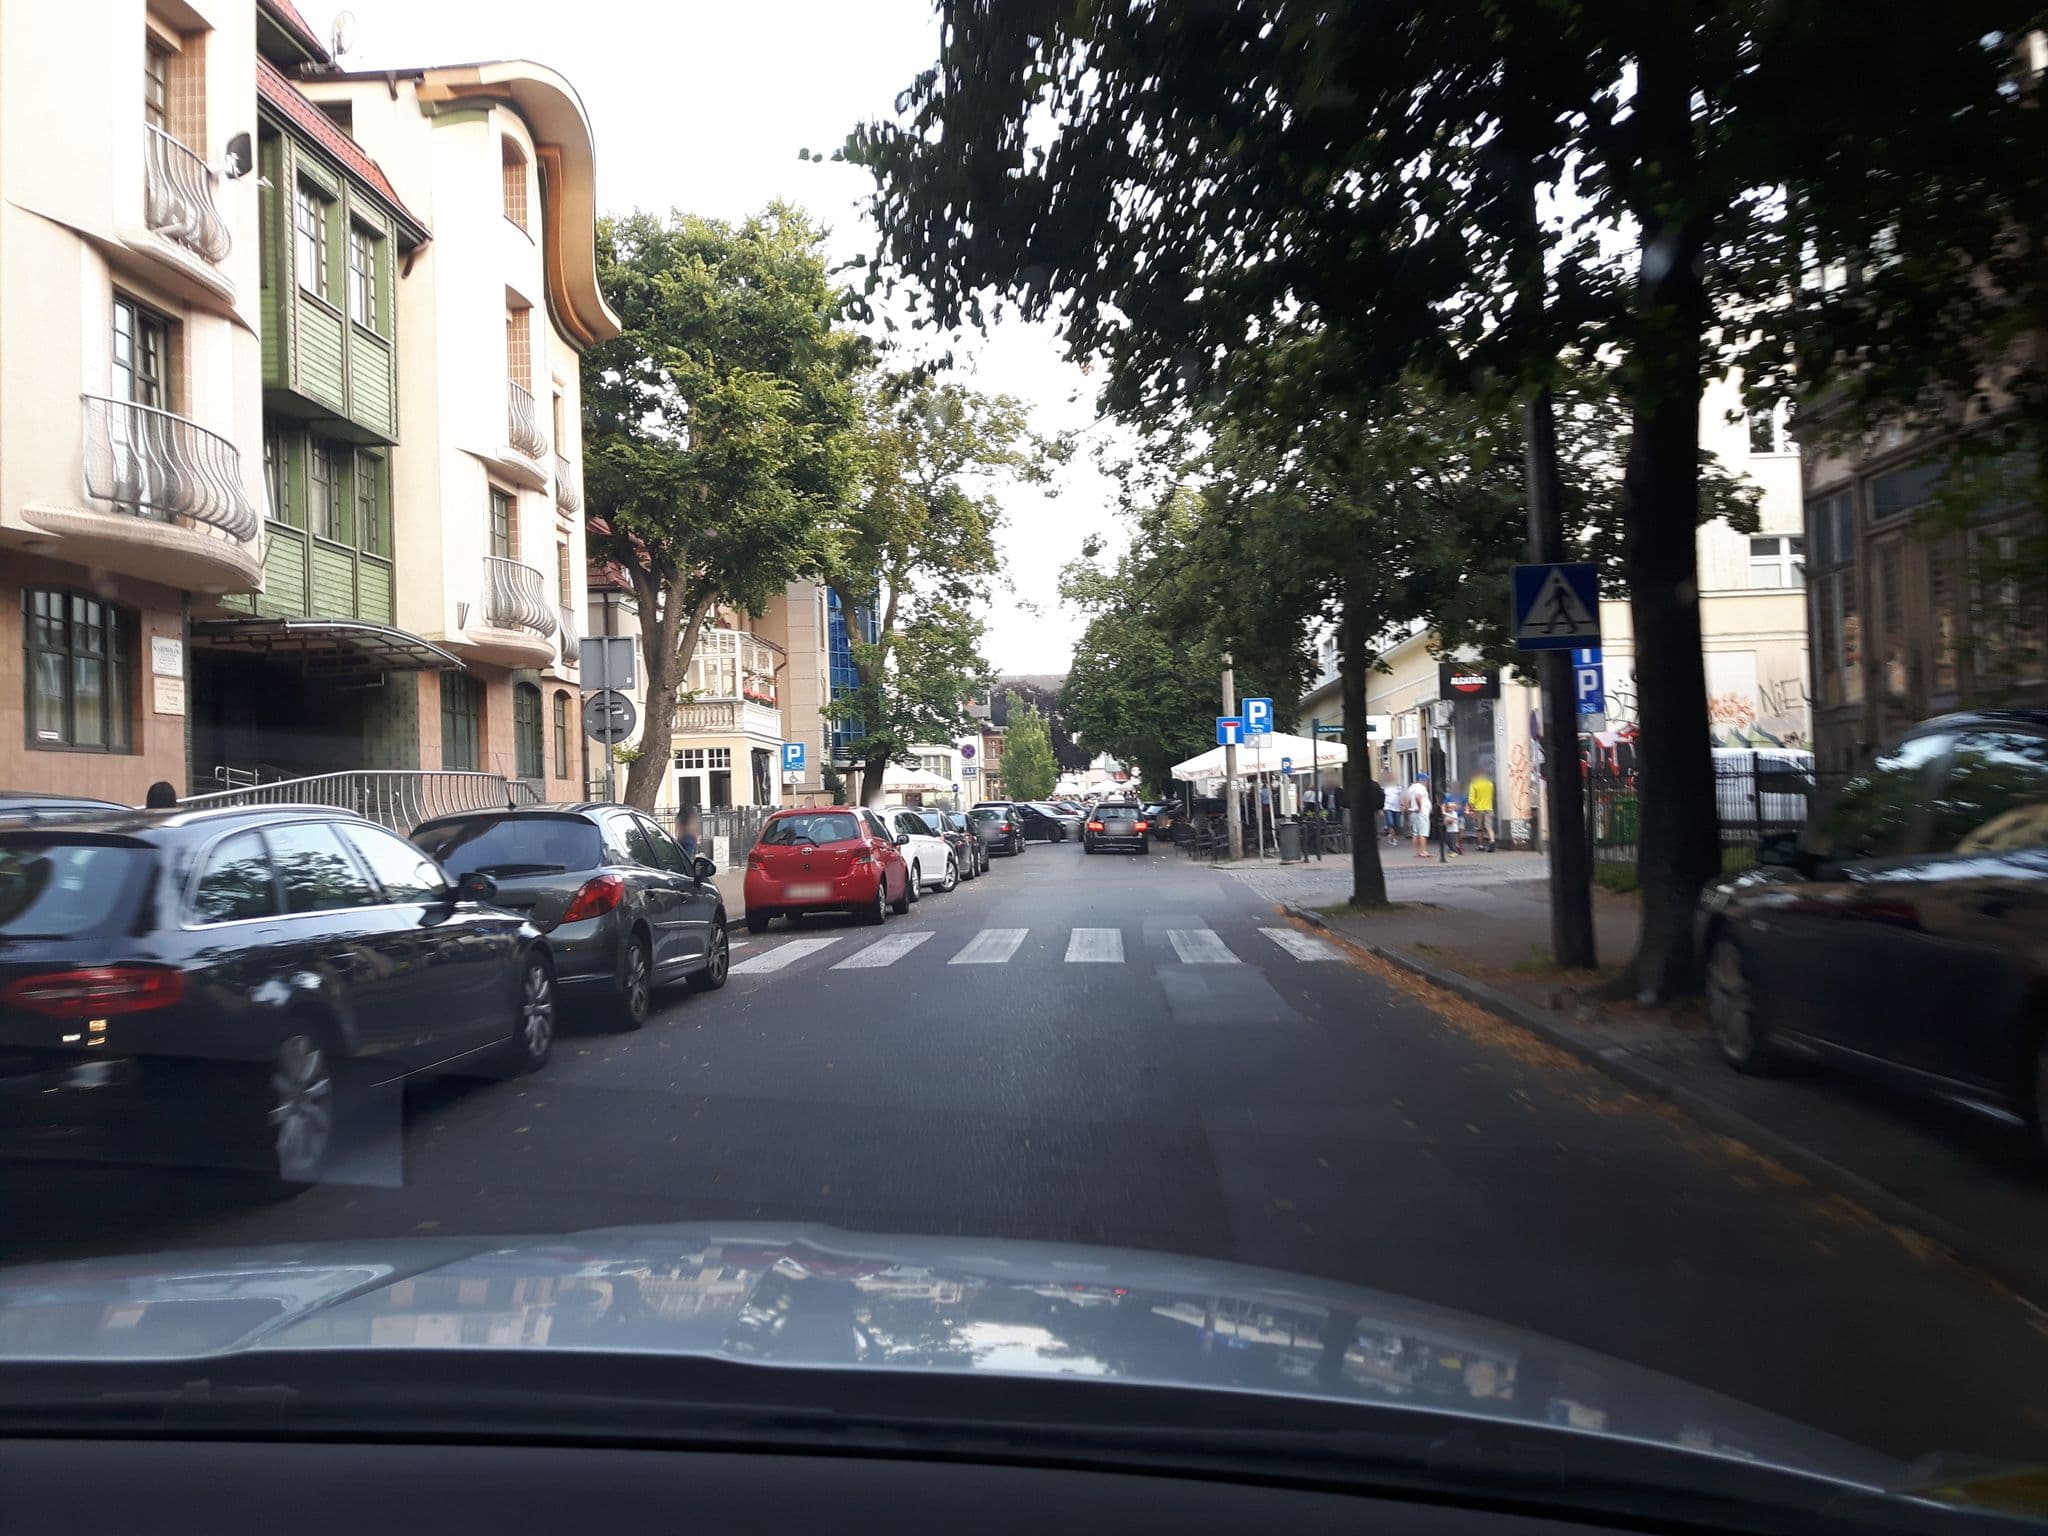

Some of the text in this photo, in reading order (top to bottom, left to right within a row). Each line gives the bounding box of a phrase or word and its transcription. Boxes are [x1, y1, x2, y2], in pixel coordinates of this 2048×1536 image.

[1578, 669, 1598, 700] P
[1249, 701, 1267, 724] P
[788, 745, 801, 763] P
[1283, 761, 1290, 769] P
